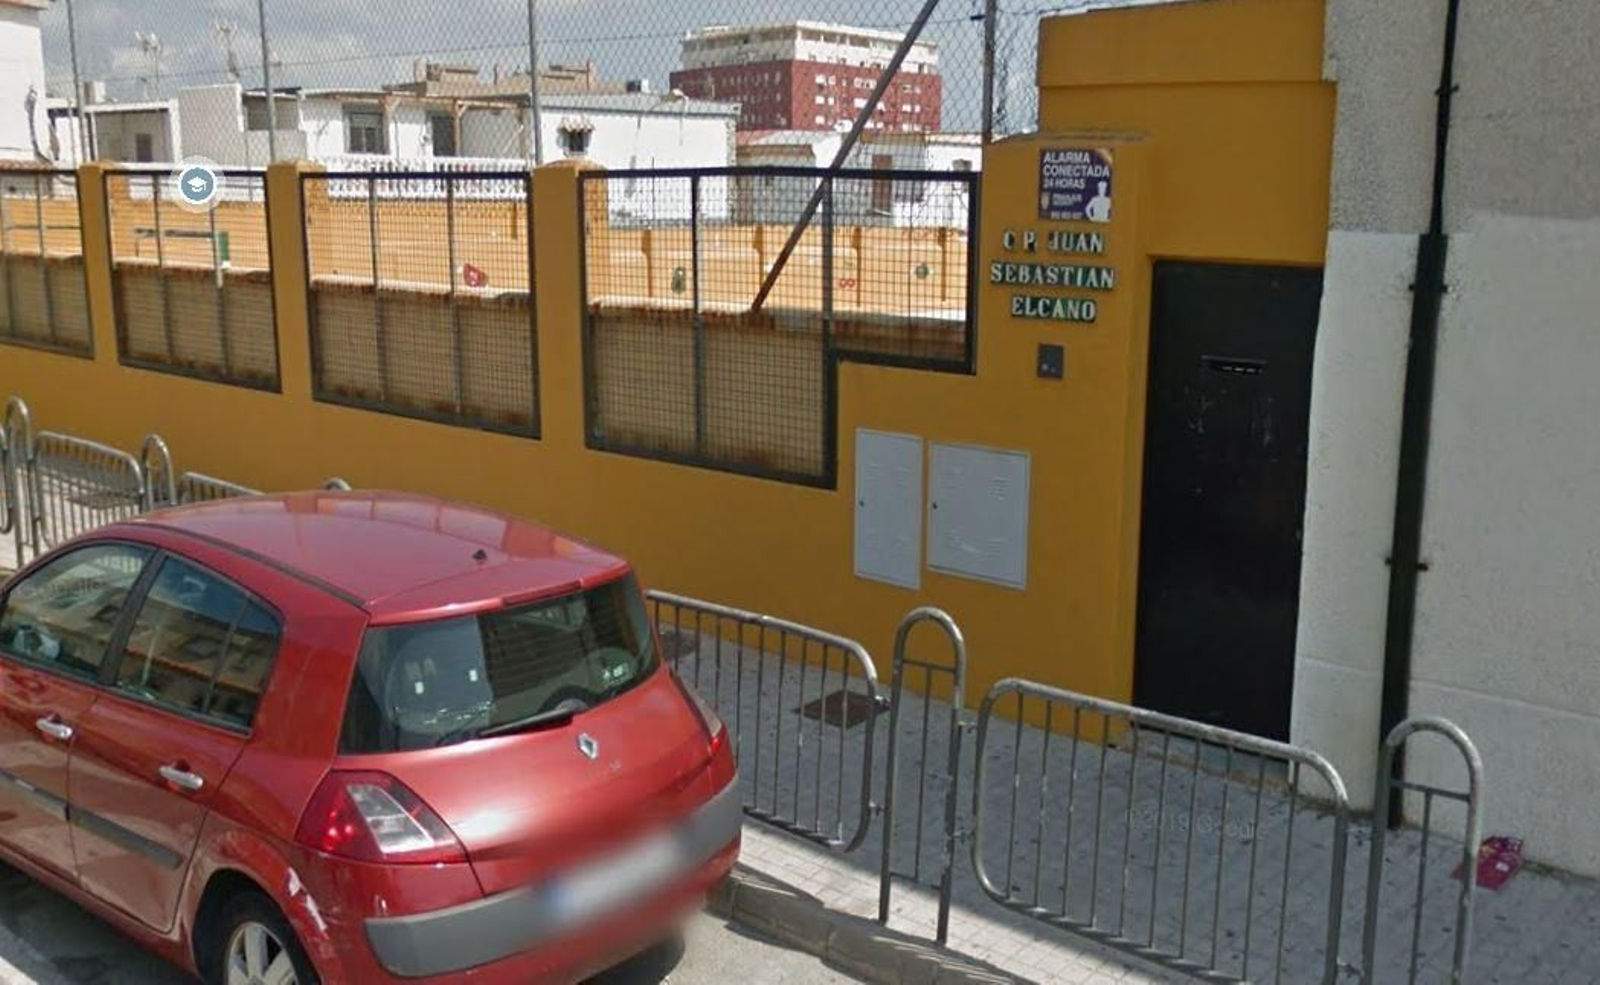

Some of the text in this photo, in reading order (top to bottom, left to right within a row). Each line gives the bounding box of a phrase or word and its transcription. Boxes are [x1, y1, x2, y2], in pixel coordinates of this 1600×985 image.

[1043, 152, 1090, 163] ALARMA
[1043, 164, 1110, 177] CONECTADA
[1055, 178, 1086, 189] HORAS
[1049, 231, 1103, 253] JUAN
[991, 262, 1114, 288] SEBASTIAN
[1012, 296, 1096, 321] ELCANO
